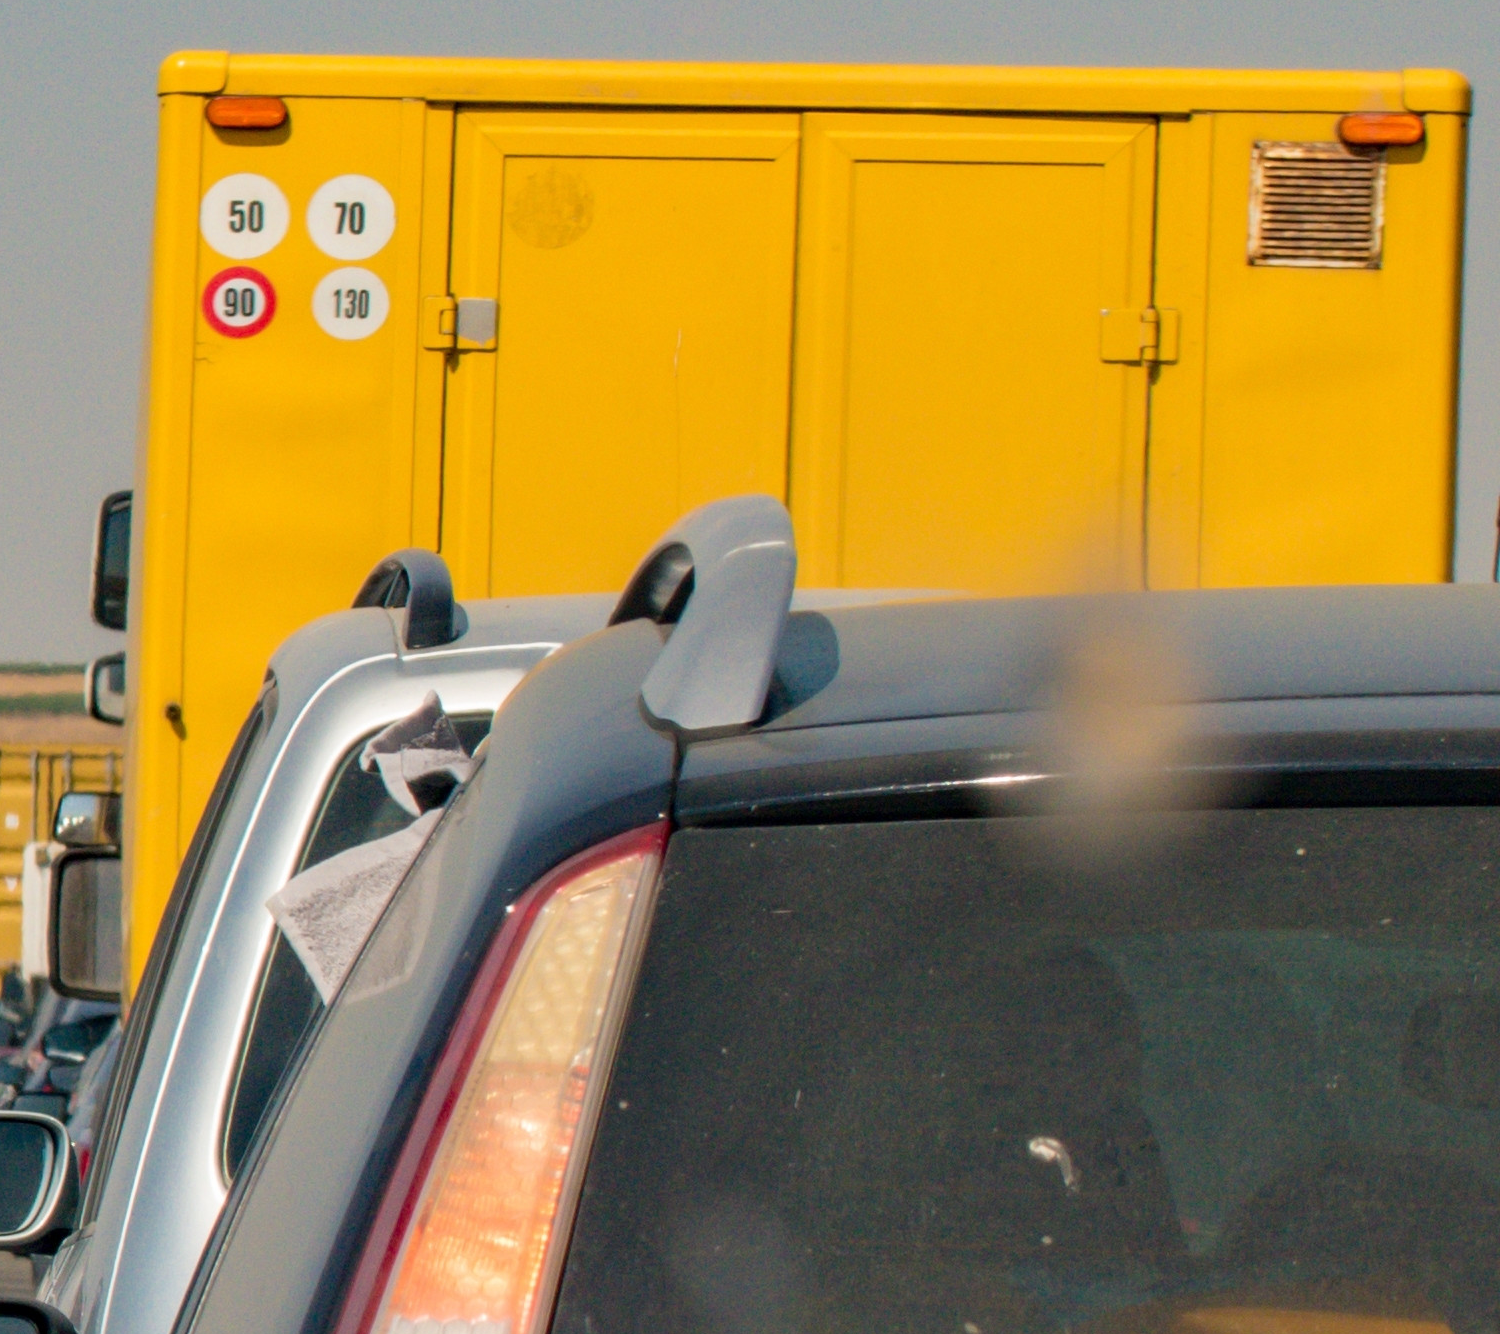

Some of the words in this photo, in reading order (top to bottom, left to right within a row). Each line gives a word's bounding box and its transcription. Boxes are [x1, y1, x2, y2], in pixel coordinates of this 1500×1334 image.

[229, 200, 264, 233] 50
[334, 202, 366, 235] 70
[224, 288, 256, 317] 90
[333, 289, 370, 319] 130
